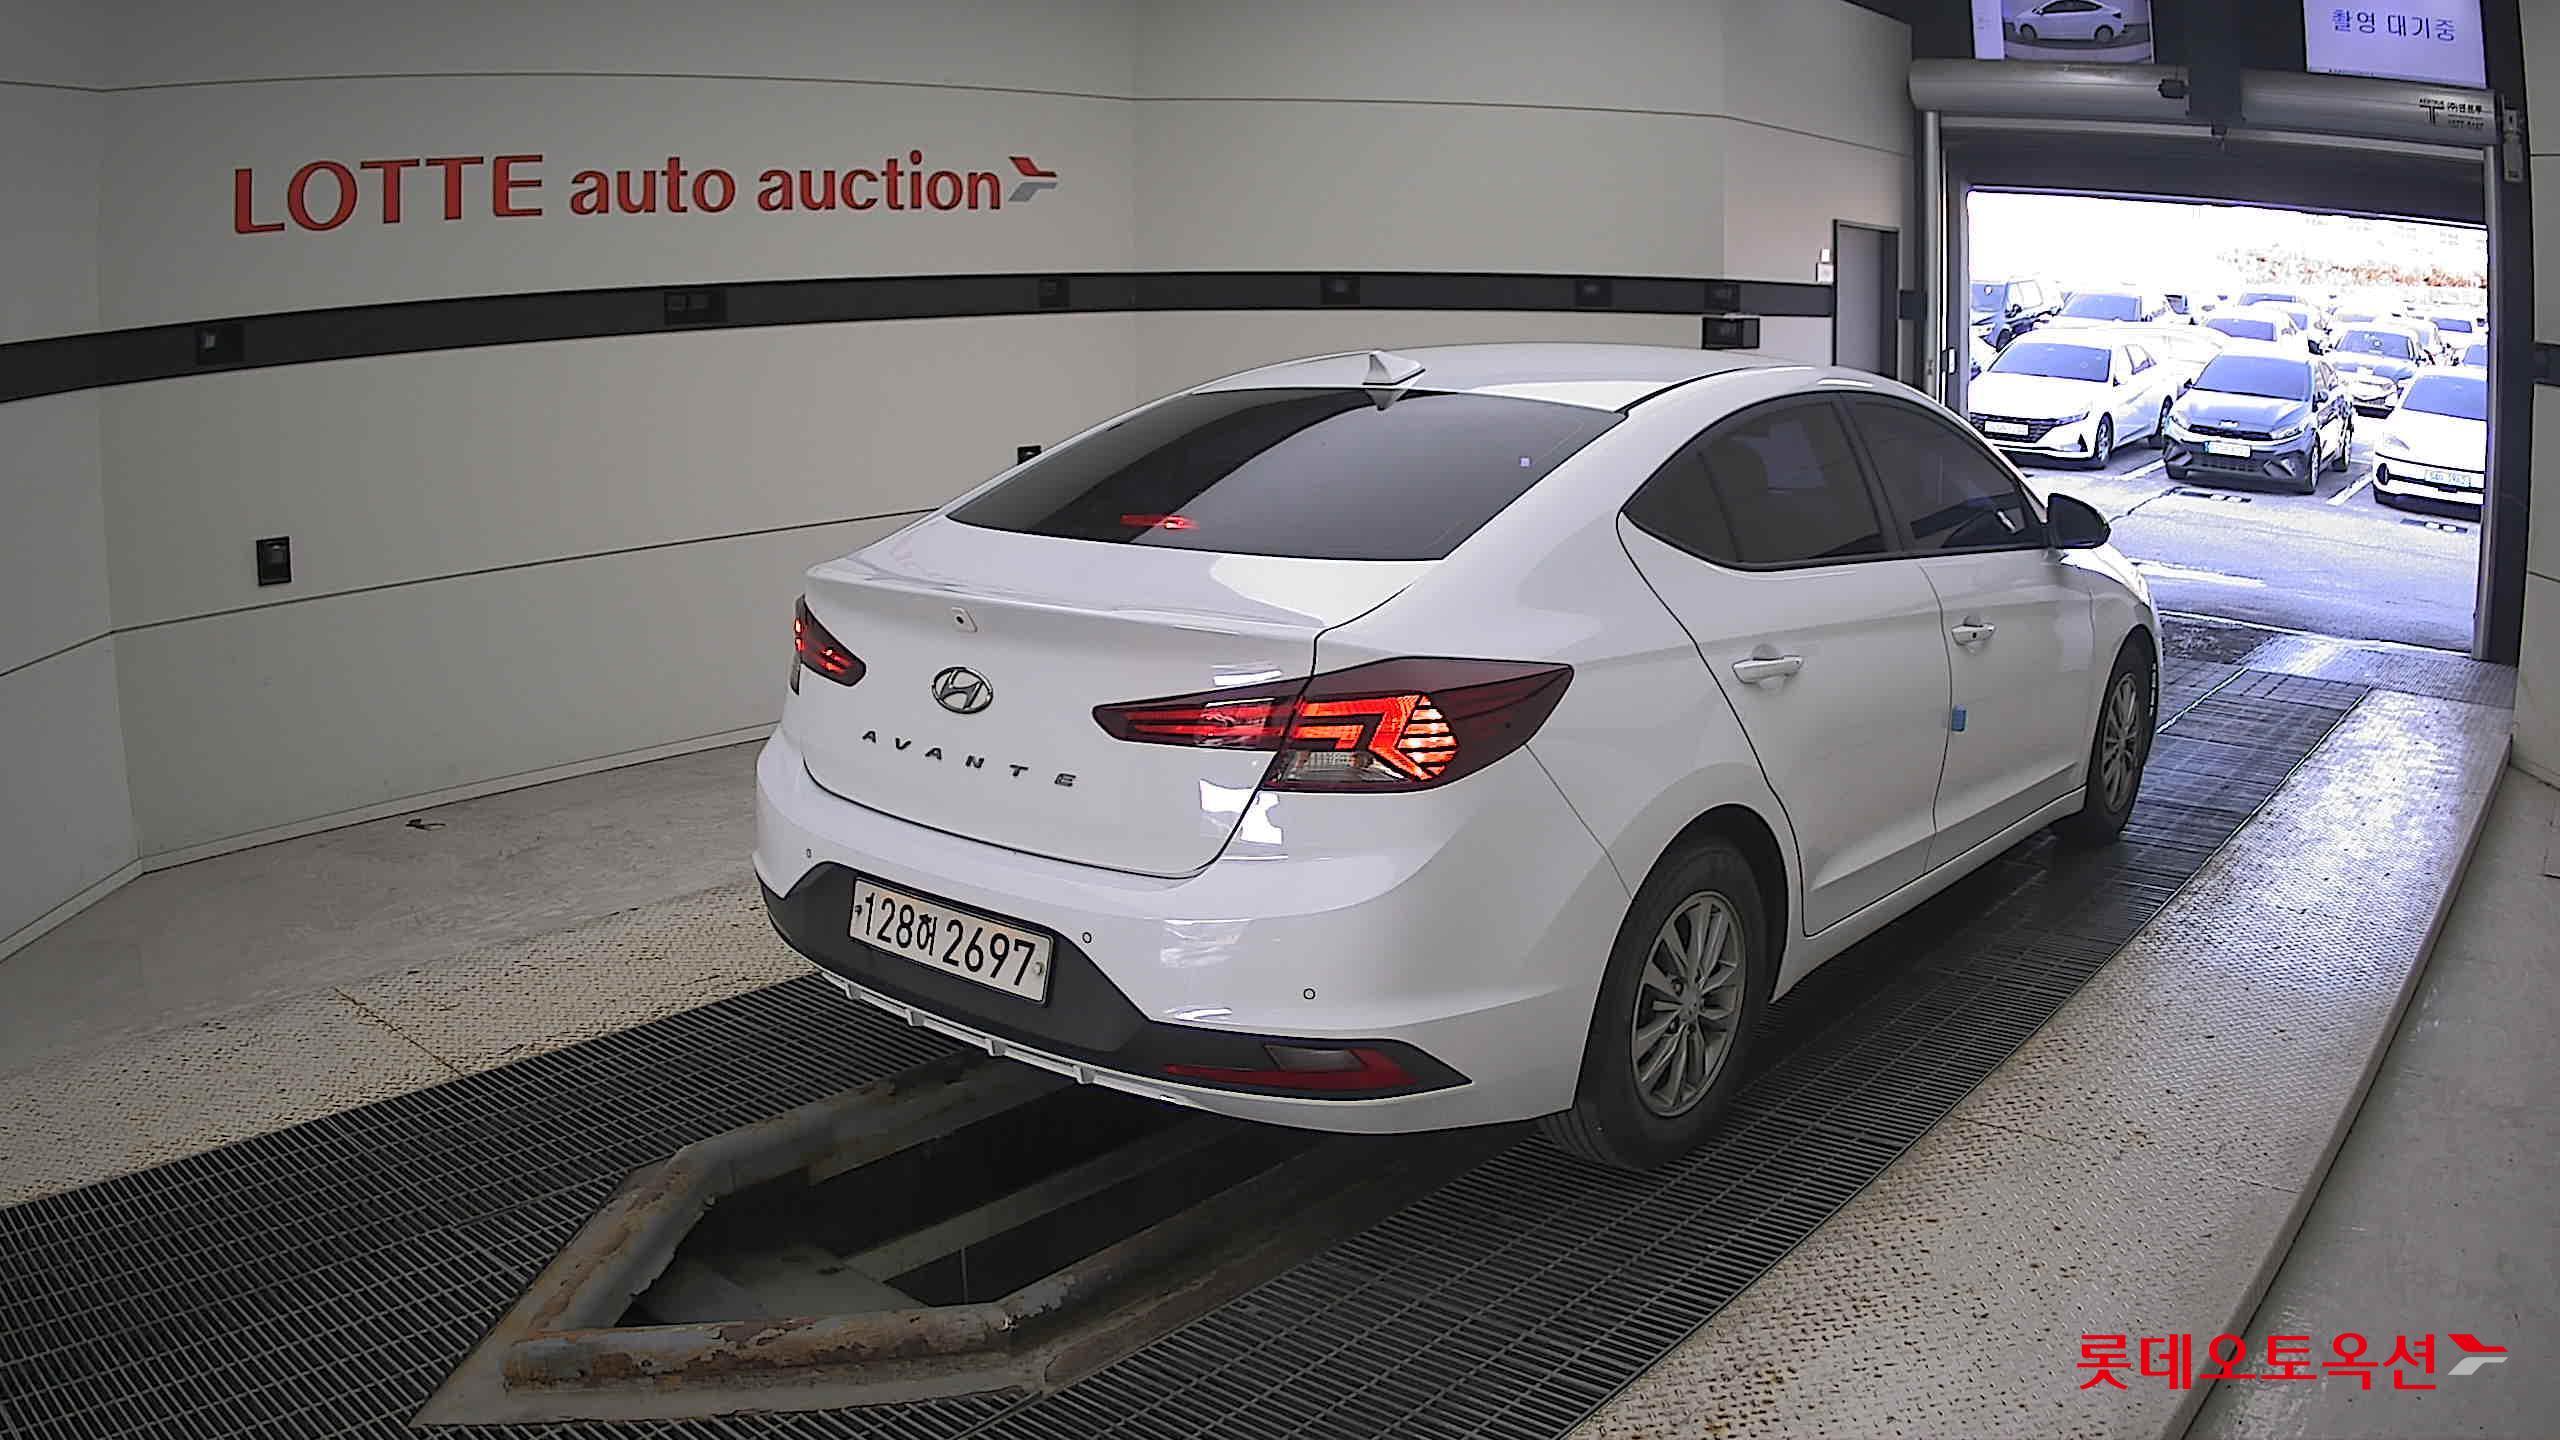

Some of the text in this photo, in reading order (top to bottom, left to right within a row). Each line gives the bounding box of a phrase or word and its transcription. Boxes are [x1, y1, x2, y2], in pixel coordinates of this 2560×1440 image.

[2331, 9, 2456, 42] 촬영 대기중
[234, 150, 1000, 234] LOTTE auto auction
[862, 732, 1077, 787] AVANTE
